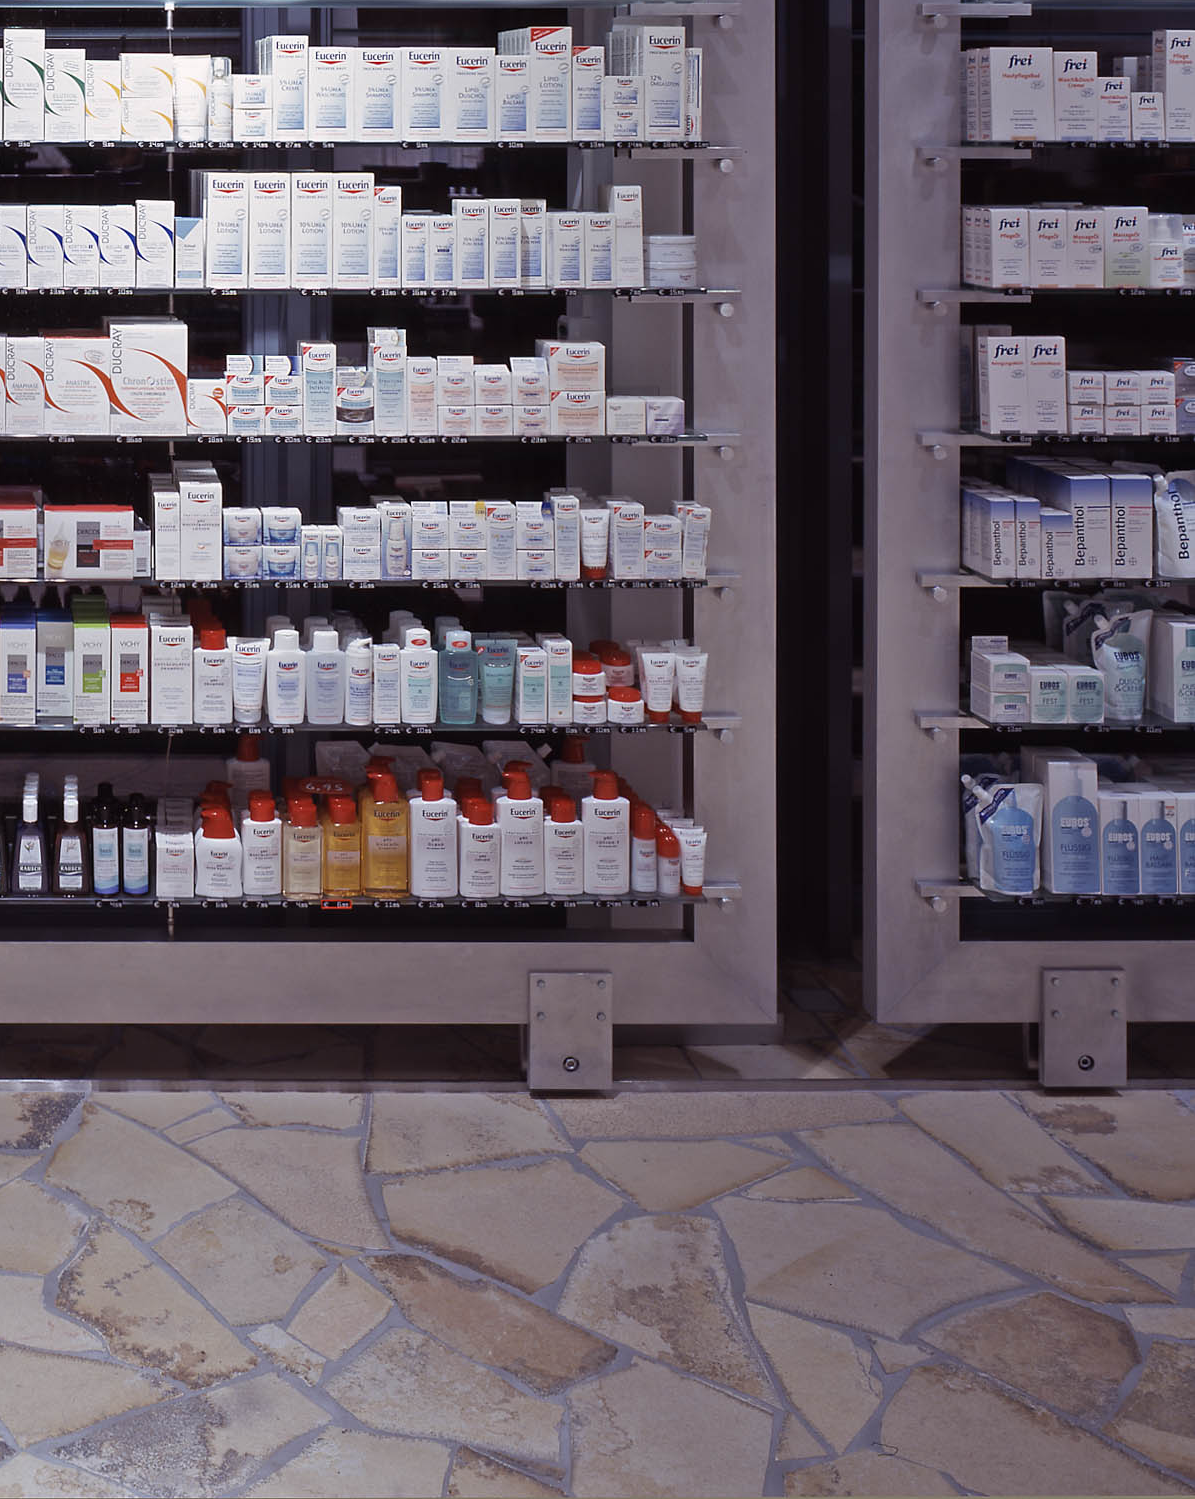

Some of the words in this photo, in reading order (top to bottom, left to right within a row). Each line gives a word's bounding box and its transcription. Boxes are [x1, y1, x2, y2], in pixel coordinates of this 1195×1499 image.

[276, 41, 305, 51] Eucerin
[535, 42, 567, 52] Eucerin
[649, 36, 681, 46] Eucerin
[1170, 37, 1191, 50] frei
[5, 37, 14, 78] DUCRAY
[315, 51, 347, 61] Eucerin
[362, 51, 394, 61] Eucerin
[408, 51, 440, 61] Eucerin
[456, 56, 488, 66] Eucerin
[576, 56, 601, 64] Eucerin
[1008, 54, 1032, 69] frei
[499, 60, 527, 69] Eucerin
[1063, 58, 1087, 72] frei
[46, 51, 55, 91] DUCRAY
[87, 62, 95, 97] DUCRAY
[1104, 81, 1123, 92] frei
[1139, 95, 1155, 105] frei
[212, 180, 245, 190] Eucerin
[254, 180, 286, 190] Eucerin
[296, 180, 329, 190] Eucerin
[338, 180, 370, 190] Eucerin
[29, 208, 37, 244] DUCRAY
[65, 208, 73, 243] DUCRAY
[138, 203, 146, 240] DUCRAY
[405, 221, 426, 229] Eucerin
[998, 218, 1020, 231] frei
[1037, 218, 1060, 232] frei
[1075, 219, 1097, 231] frei
[1114, 216, 1137, 230] frei
[1161, 247, 1178, 257] frei
[112, 328, 122, 374] DUCRAY
[994, 343, 1019, 359] frei
[1032, 343, 1058, 359] frei
[7, 342, 15, 380] DUCRAY
[45, 340, 54, 382] DUCRAY
[1080, 377, 1094, 386] frei
[1116, 378, 1130, 387] frei
[1168, 490, 1190, 560] Bepanthol
[1075, 505, 1087, 566] Bepanthol
[1115, 505, 1127, 566] Bepanthol
[993, 520, 1001, 566] Bepanthol
[1018, 521, 1027, 566] Bepanthol
[1046, 531, 1054, 578] Bepanthol
[158, 635, 185, 644] Eucerin
[373, 809, 400, 819] Eucerin
[421, 809, 448, 819] Eucerin
